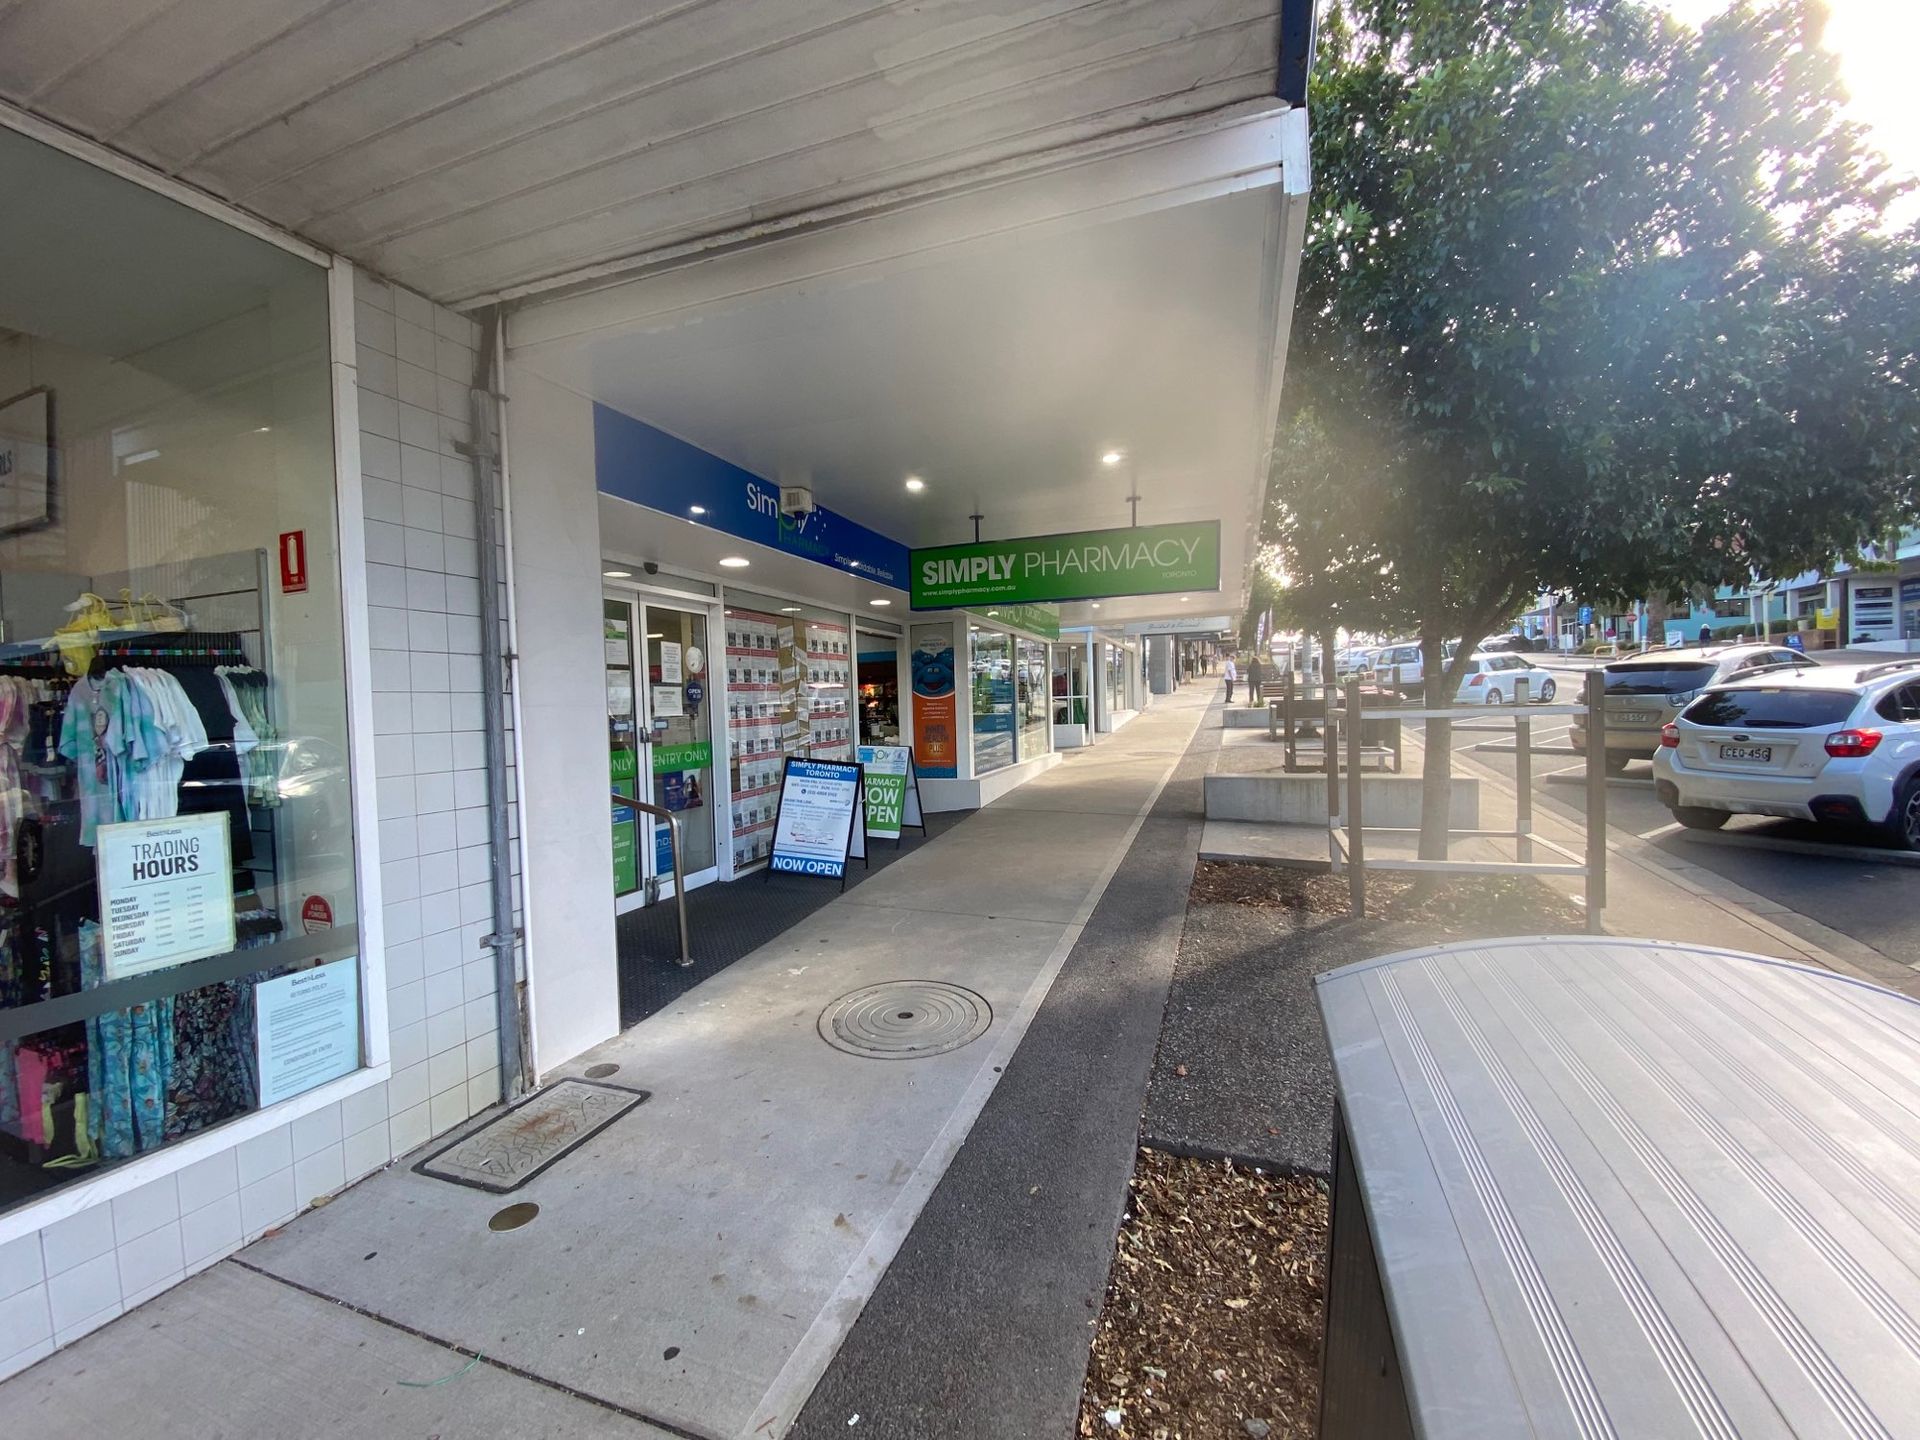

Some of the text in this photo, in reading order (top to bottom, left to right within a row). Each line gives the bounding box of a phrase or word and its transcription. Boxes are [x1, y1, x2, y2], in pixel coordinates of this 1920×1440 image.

[922, 536, 1200, 586] SIMPLY PHARMACY
[1162, 569, 1197, 578] TORONTO
[922, 585, 1016, 597] www.simplypharmacy.com.au
[653, 749, 708, 768] ENTRY ONLY
[613, 758, 633, 772] NLY
[790, 761, 857, 774] SIMPLY PHARMACY
[805, 769, 840, 779] TORONTO
[865, 777, 901, 787] ARMACY
[866, 787, 899, 804] OW
[866, 805, 898, 823] PEN
[132, 837, 200, 861] TRADING
[132, 854, 199, 881] HOURS
[773, 857, 842, 876] NOW OPEN
[110, 896, 137, 906] MONDAY
[111, 904, 140, 914] TUESDAY
[111, 911, 149, 923] WEDNESDAY
[112, 920, 145, 932] THURSDAY
[113, 930, 135, 940] FRIDAY
[113, 936, 146, 949] SATURDAY
[114, 946, 139, 957] SUNDAY
